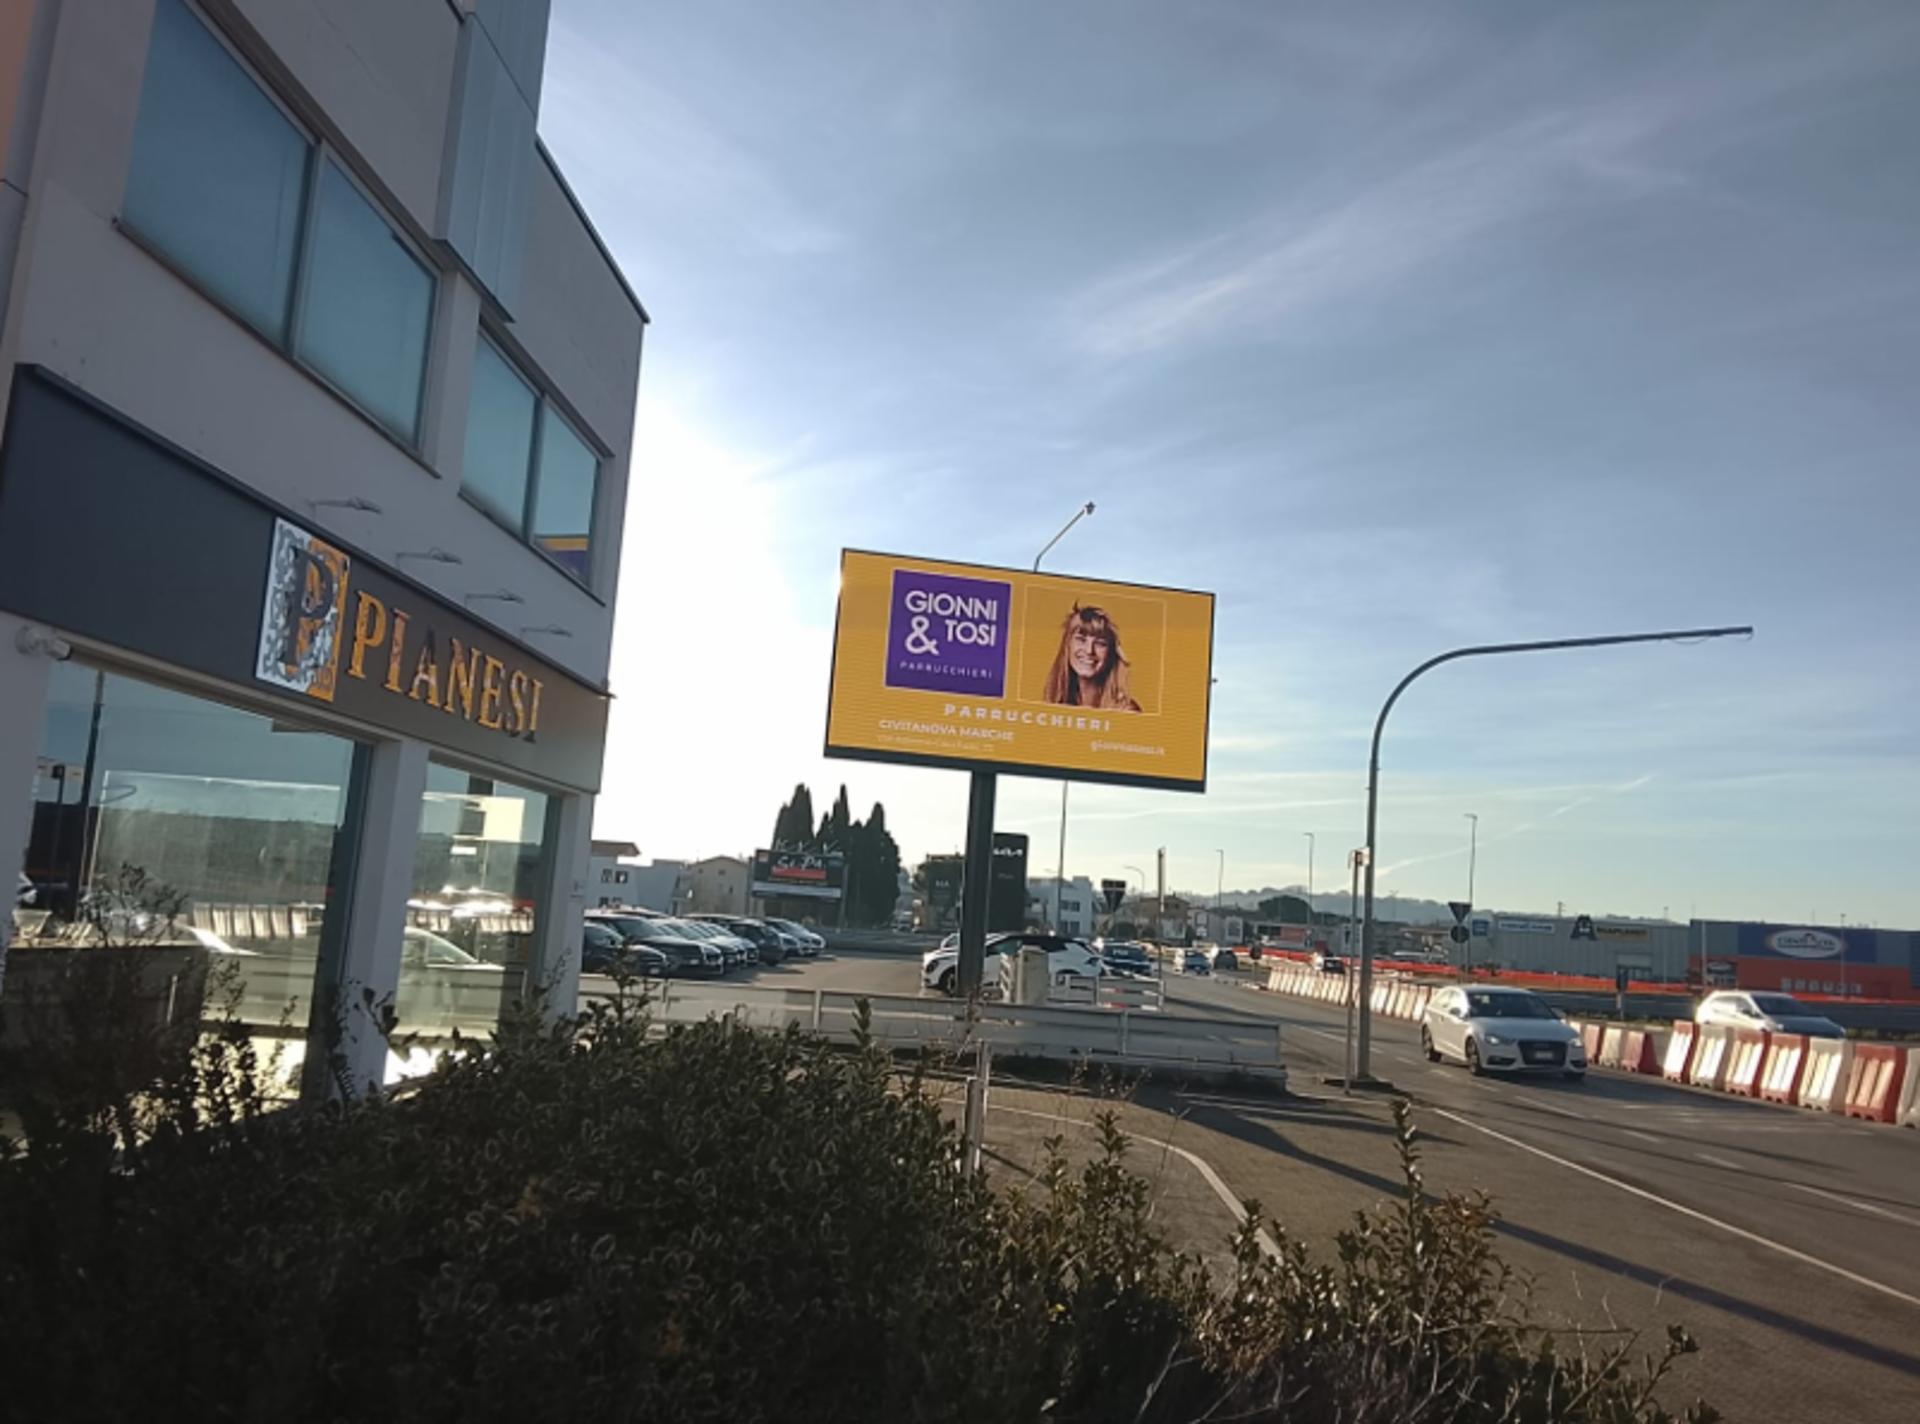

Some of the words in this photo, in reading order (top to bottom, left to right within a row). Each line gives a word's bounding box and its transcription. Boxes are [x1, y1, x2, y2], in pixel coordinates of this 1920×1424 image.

[905, 590, 998, 621] GIONNI
[905, 615, 940, 656] &
[944, 618, 997, 647] TOSI
[347, 589, 545, 742] PIANESI
[899, 660, 993, 679] PARRUCCHIERI
[878, 719, 957, 737] CIVITANOVA
[959, 726, 1014, 742] MARCHE
[943, 703, 1111, 732] PARRUCCHIERI
